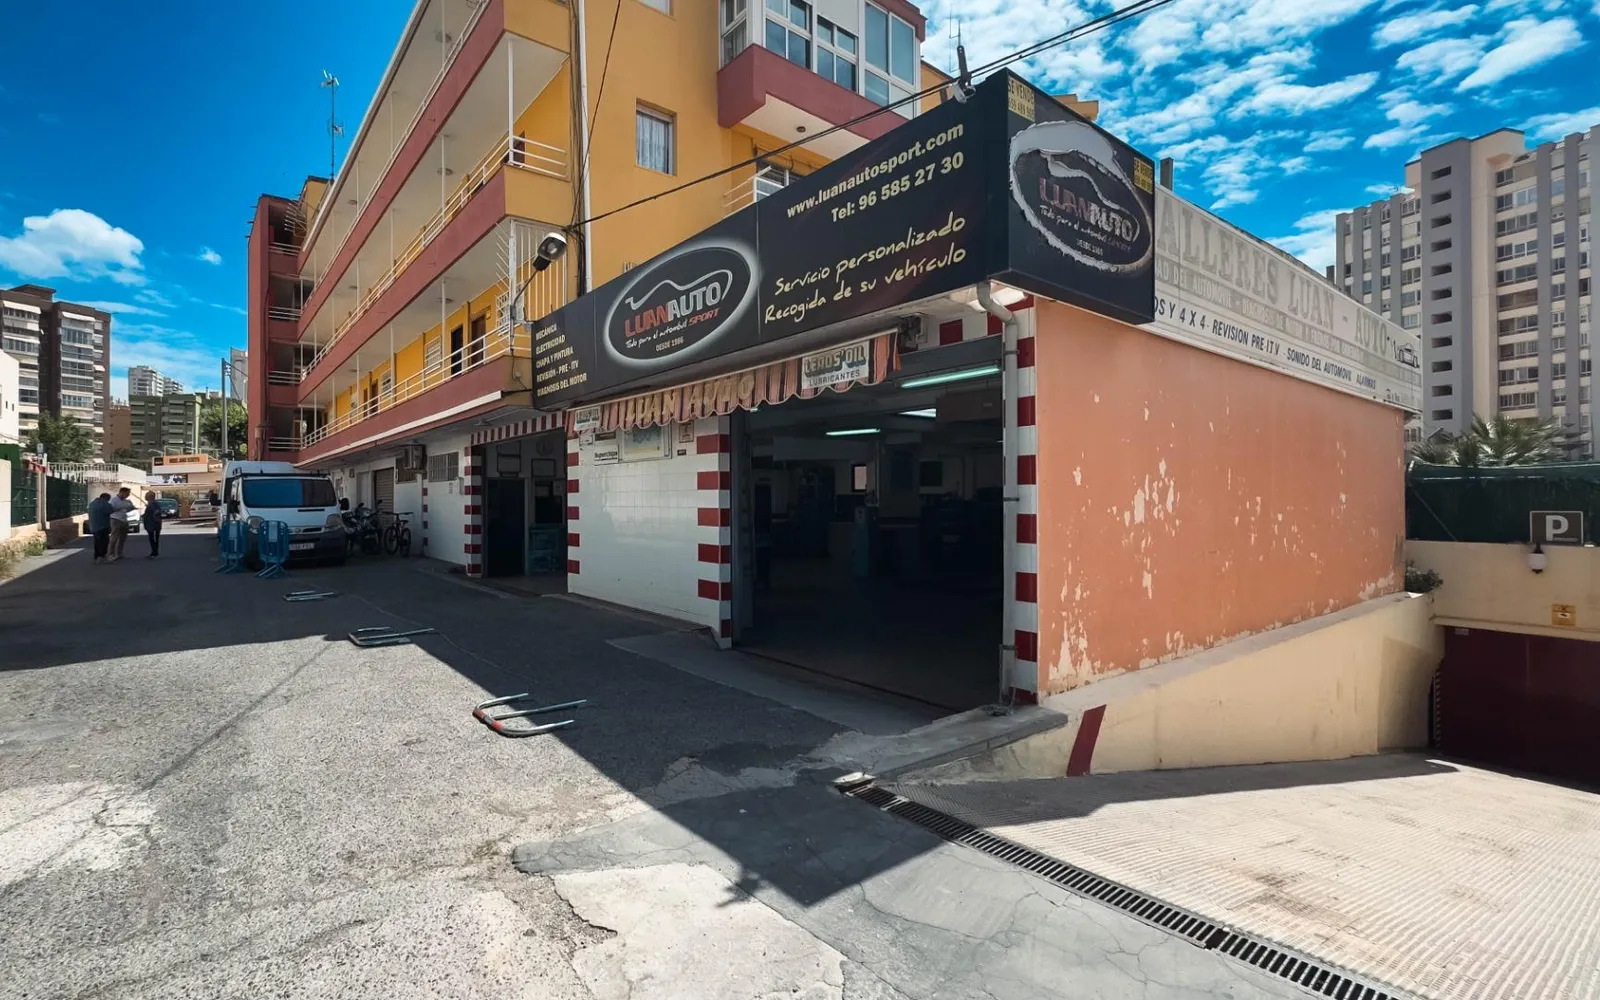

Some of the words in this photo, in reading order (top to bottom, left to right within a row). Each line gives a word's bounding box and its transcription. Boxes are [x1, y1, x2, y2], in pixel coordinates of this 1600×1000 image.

[786, 123, 964, 218] www.luanautosport.com
[830, 202, 856, 222] Tel:
[858, 191, 877, 211] 96
[881, 175, 910, 202] 585
[914, 162, 936, 187] 27
[940, 152, 964, 175] 30
[774, 266, 830, 296] Servicio
[836, 211, 966, 284] personalizado
[624, 281, 722, 338] LUANAUTO
[764, 288, 827, 324] Recogida
[833, 280, 852, 302] de
[860, 278, 878, 294] su
[884, 242, 966, 285] vehículo
[688, 308, 720, 326] SPORT
[1169, 302, 1176, 319] Y
[1180, 308, 1186, 323] 4
[1189, 310, 1197, 327] X
[1212, 319, 1249, 345] REVISION
[1286, 348, 1310, 367] SONIDO
[1312, 357, 1322, 371] DEL
[1288, 272, 1334, 332] LUAN
[1355, 307, 1388, 356] AUTO
[554, 346, 574, 362] PINTURA
[559, 363, 569, 375] PRE
[560, 379, 569, 390] DEL
[570, 372, 587, 386] MOTOR
[809, 369, 861, 386] LUBRICANTES
[1545, 514, 1569, 542] P
